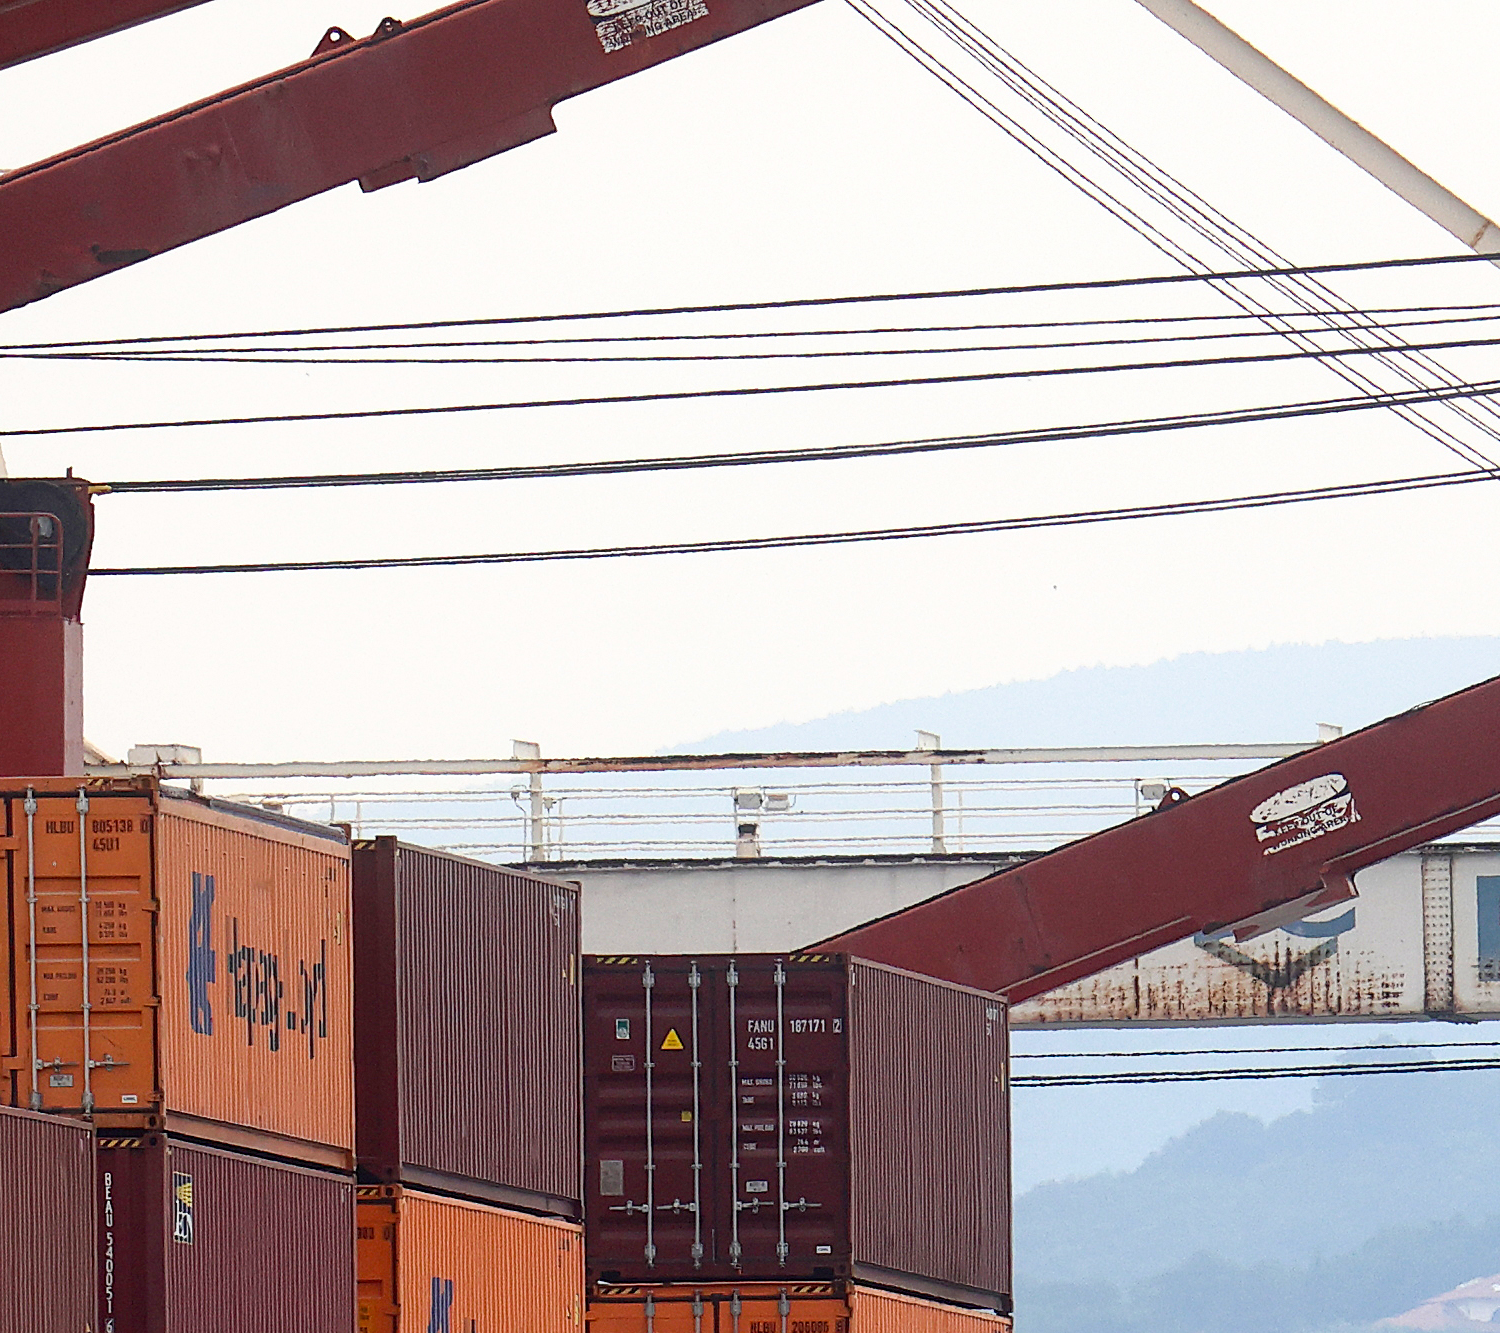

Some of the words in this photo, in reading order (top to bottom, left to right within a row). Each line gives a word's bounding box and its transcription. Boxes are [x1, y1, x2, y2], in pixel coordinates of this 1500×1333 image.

[1301, 810, 1322, 827] OUT
[747, 1019, 775, 1033] FANU
[789, 1019, 826, 1033] 187171
[747, 1037, 774, 1051] 45G1
[104, 1172, 114, 1228] BEAU
[105, 1231, 115, 1314] 540051
